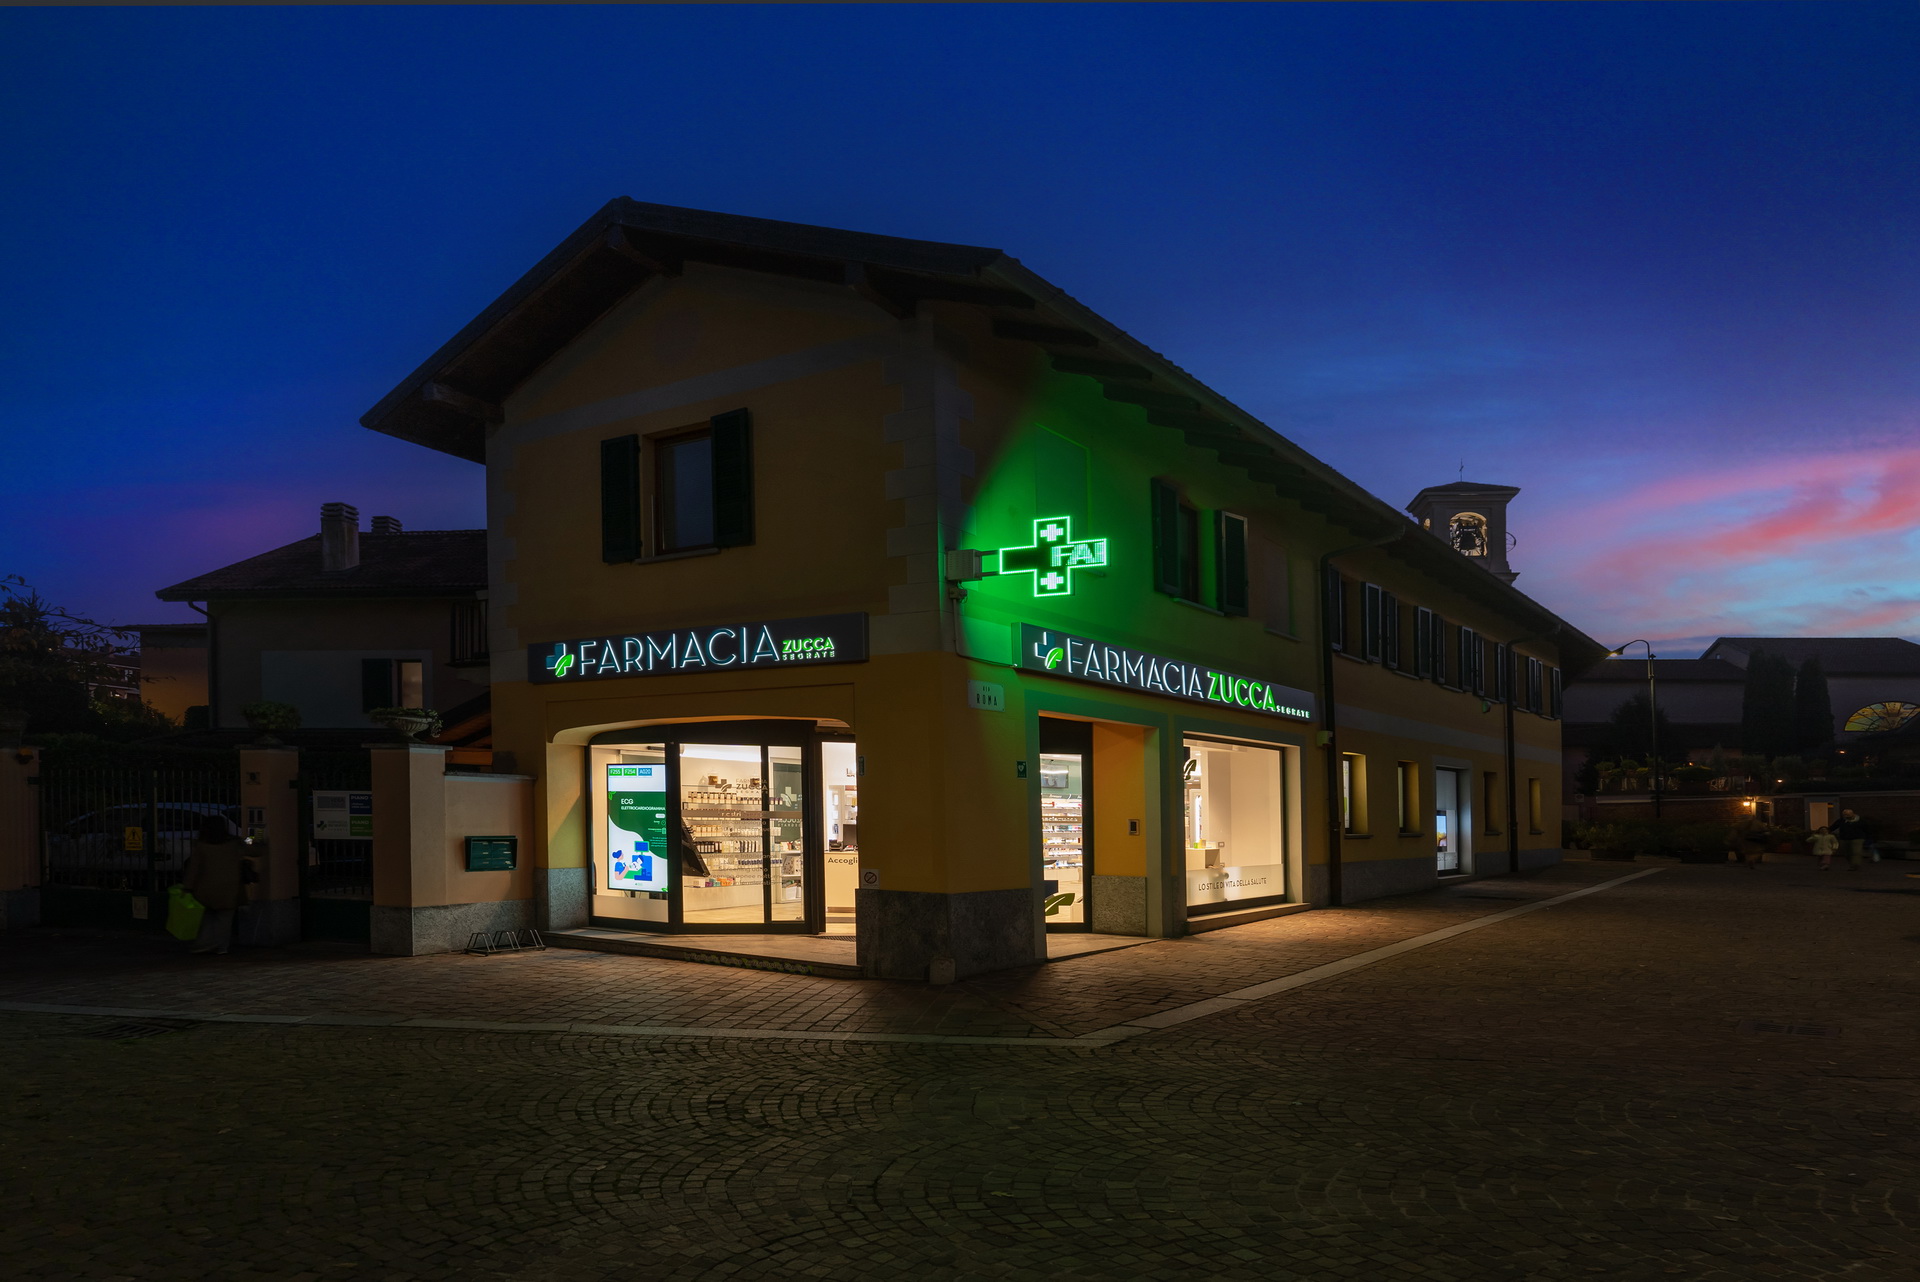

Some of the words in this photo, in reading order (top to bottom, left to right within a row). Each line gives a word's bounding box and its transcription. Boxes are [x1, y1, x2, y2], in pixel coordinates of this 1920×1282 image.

[580, 625, 780, 675] FARMACIA
[782, 636, 835, 653] ZUCCA
[782, 650, 835, 661] SEGRATE
[1066, 637, 1204, 699] FARMACIA
[1207, 670, 1277, 712] ZUCCA
[1276, 704, 1310, 719] SEGRATE
[976, 694, 998, 706] ROMA
[1198, 883, 1206, 891] LO
[1225, 880, 1236, 888] VITA
[1236, 879, 1250, 887] DELLA
